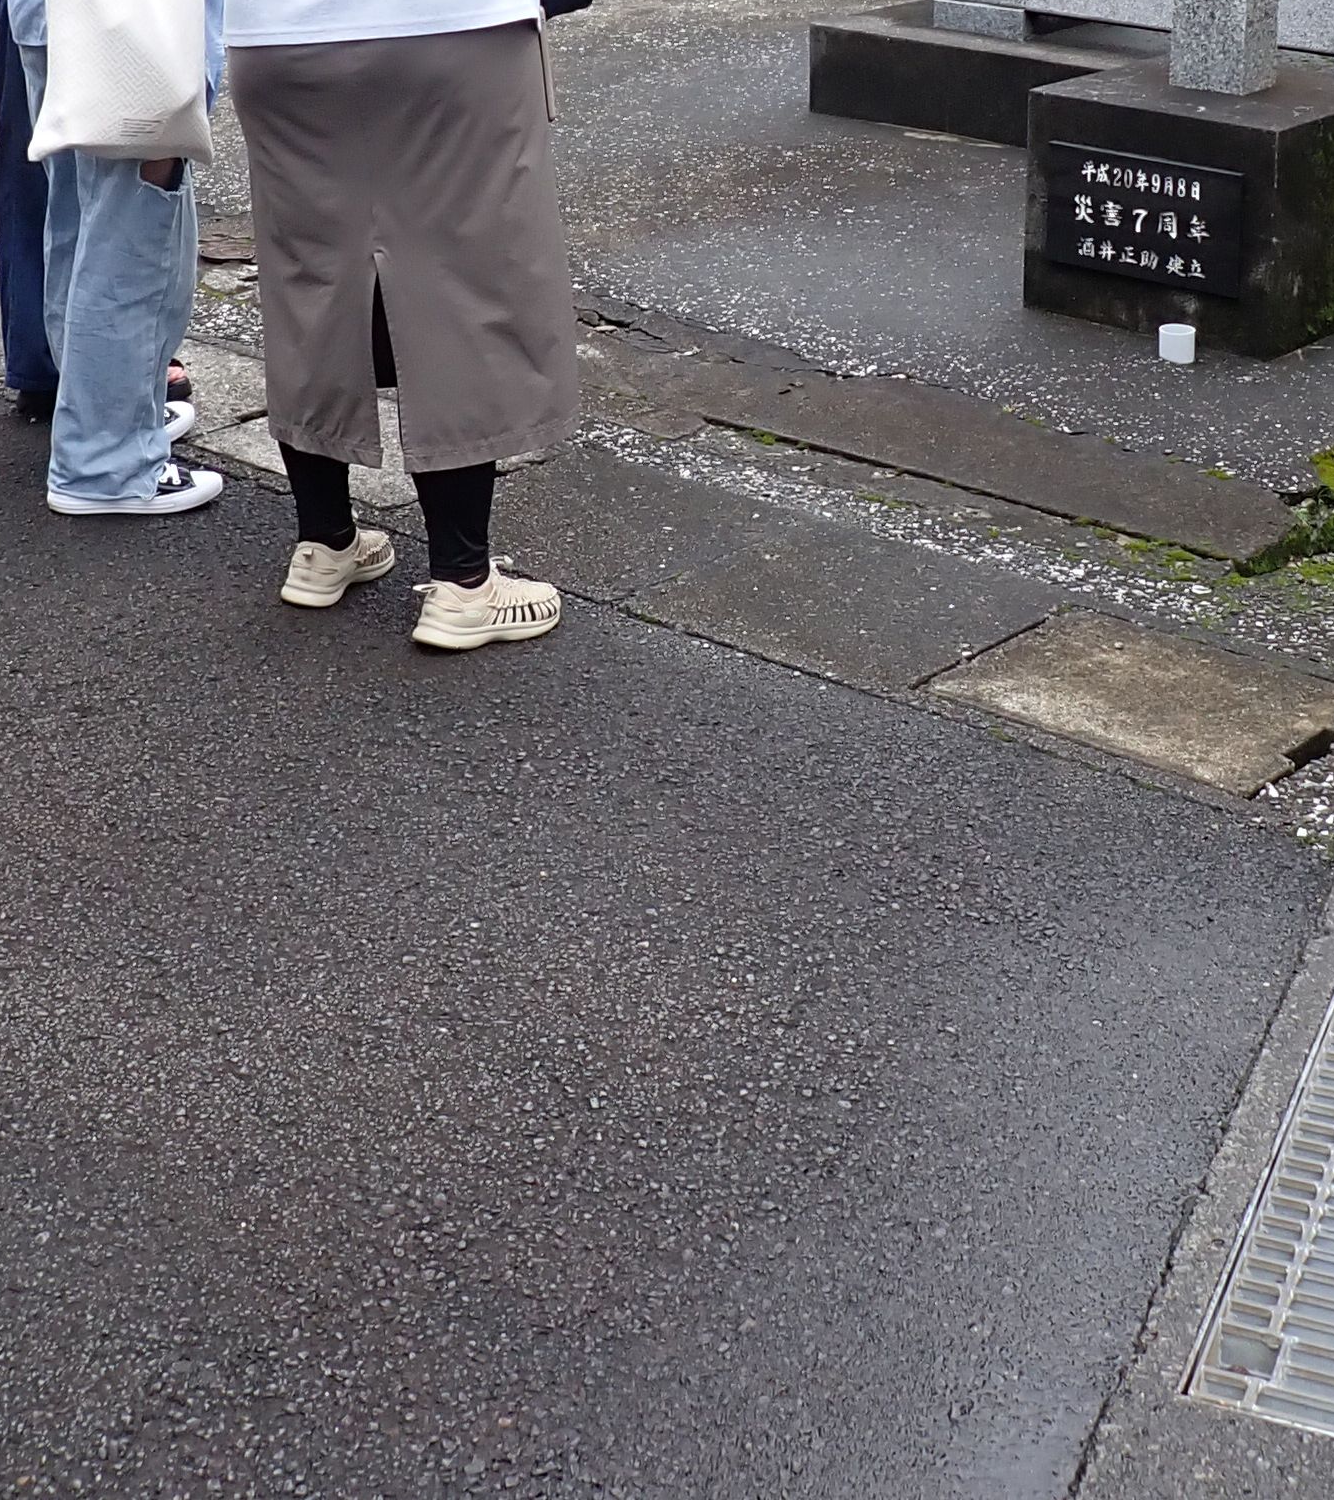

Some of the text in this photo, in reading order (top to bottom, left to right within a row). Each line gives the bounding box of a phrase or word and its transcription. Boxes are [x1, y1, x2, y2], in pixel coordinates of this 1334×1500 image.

[1073, 193, 1211, 244] 災害7周年
[1165, 252, 1207, 279] 建立
